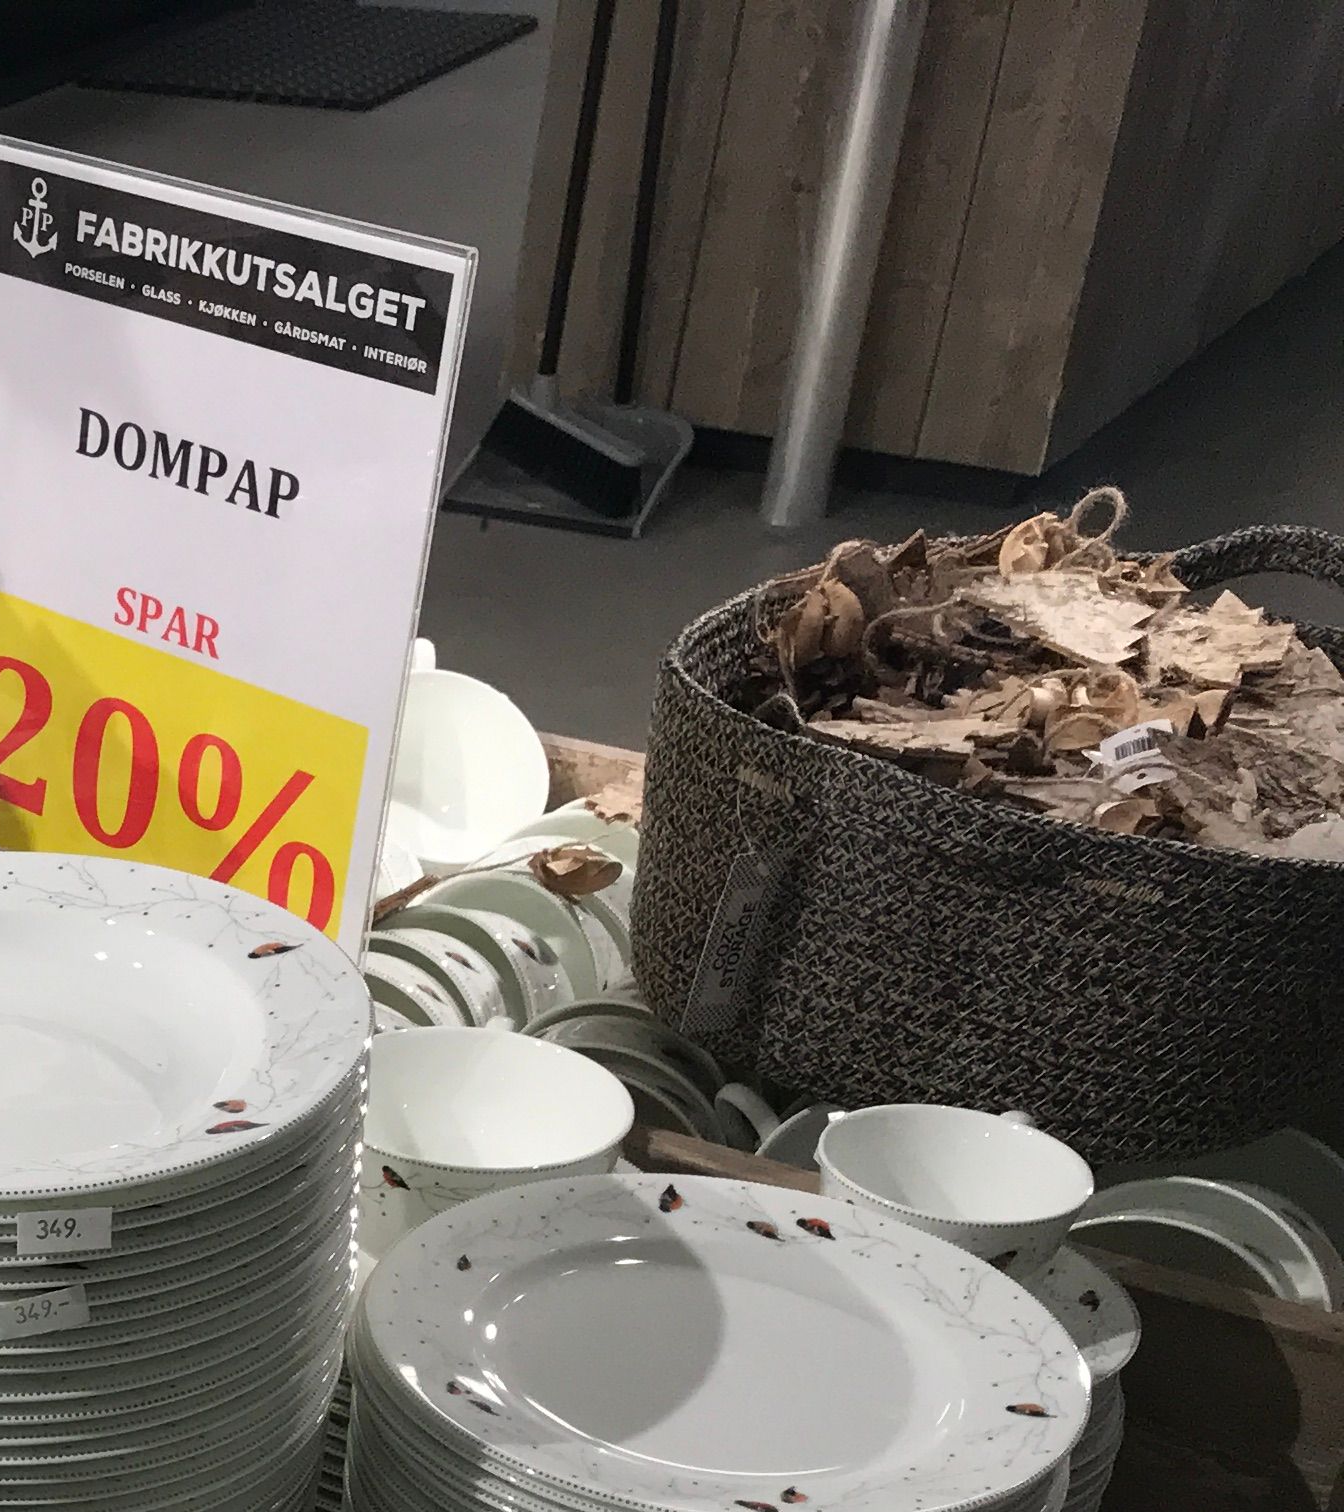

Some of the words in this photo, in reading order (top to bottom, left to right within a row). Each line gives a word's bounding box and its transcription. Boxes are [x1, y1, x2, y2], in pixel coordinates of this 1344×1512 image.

[76, 210, 426, 332] FABRIKKUTSALGET
[65, 262, 125, 290] PORSELEN
[142, 284, 181, 306] GLASS
[198, 299, 257, 327] KJØKKEN
[274, 320, 346, 351] GÅRDSMAT
[363, 345, 428, 374] INTERIØR
[75, 407, 301, 519] DOMPAP
[113, 586, 221, 660] SPAR
[713, 920, 738, 971] COZY
[719, 901, 756, 989] STORAGE
[35, 1217, 82, 1240] 349.
[13, 1299, 70, 1324] 349.-
